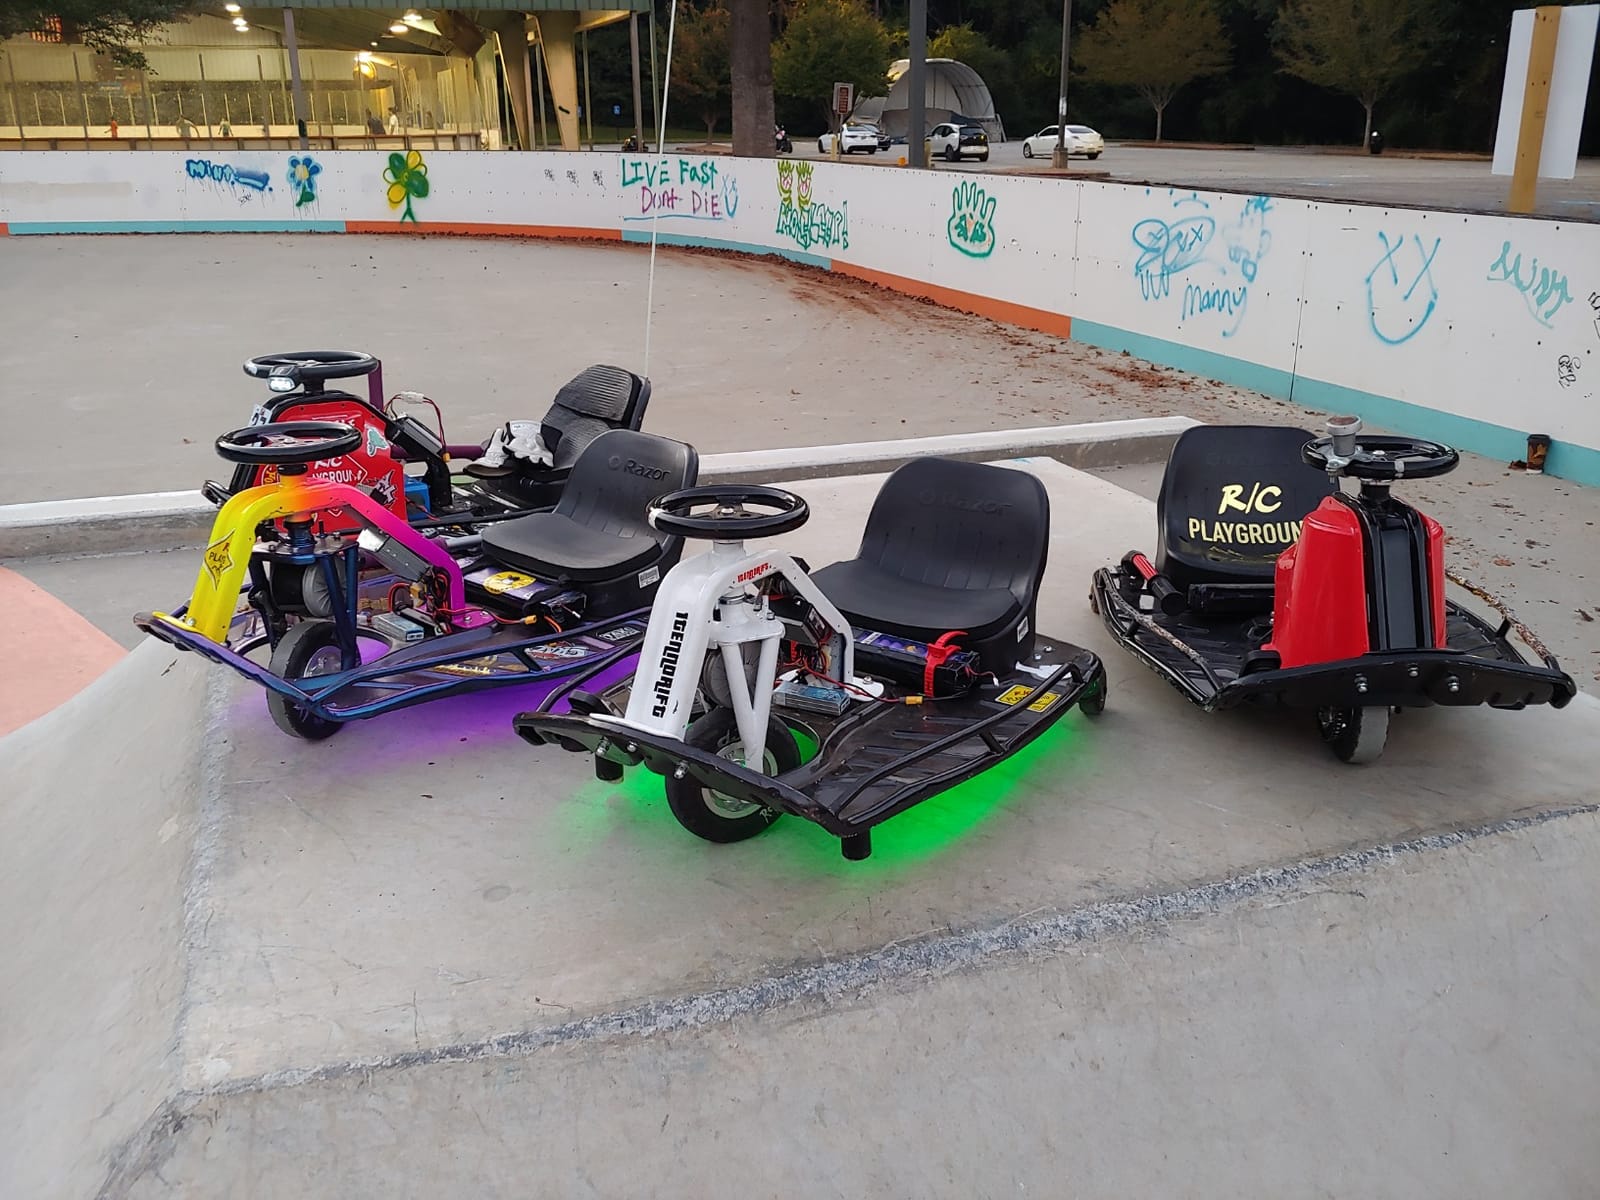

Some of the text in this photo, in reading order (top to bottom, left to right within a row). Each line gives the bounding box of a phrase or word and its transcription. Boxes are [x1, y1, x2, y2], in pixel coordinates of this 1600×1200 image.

[621, 158, 670, 188] LIVE
[623, 457, 673, 481] Razor
[1218, 481, 1282, 515] R/C
[1188, 517, 1304, 544] PLAYGROUN
